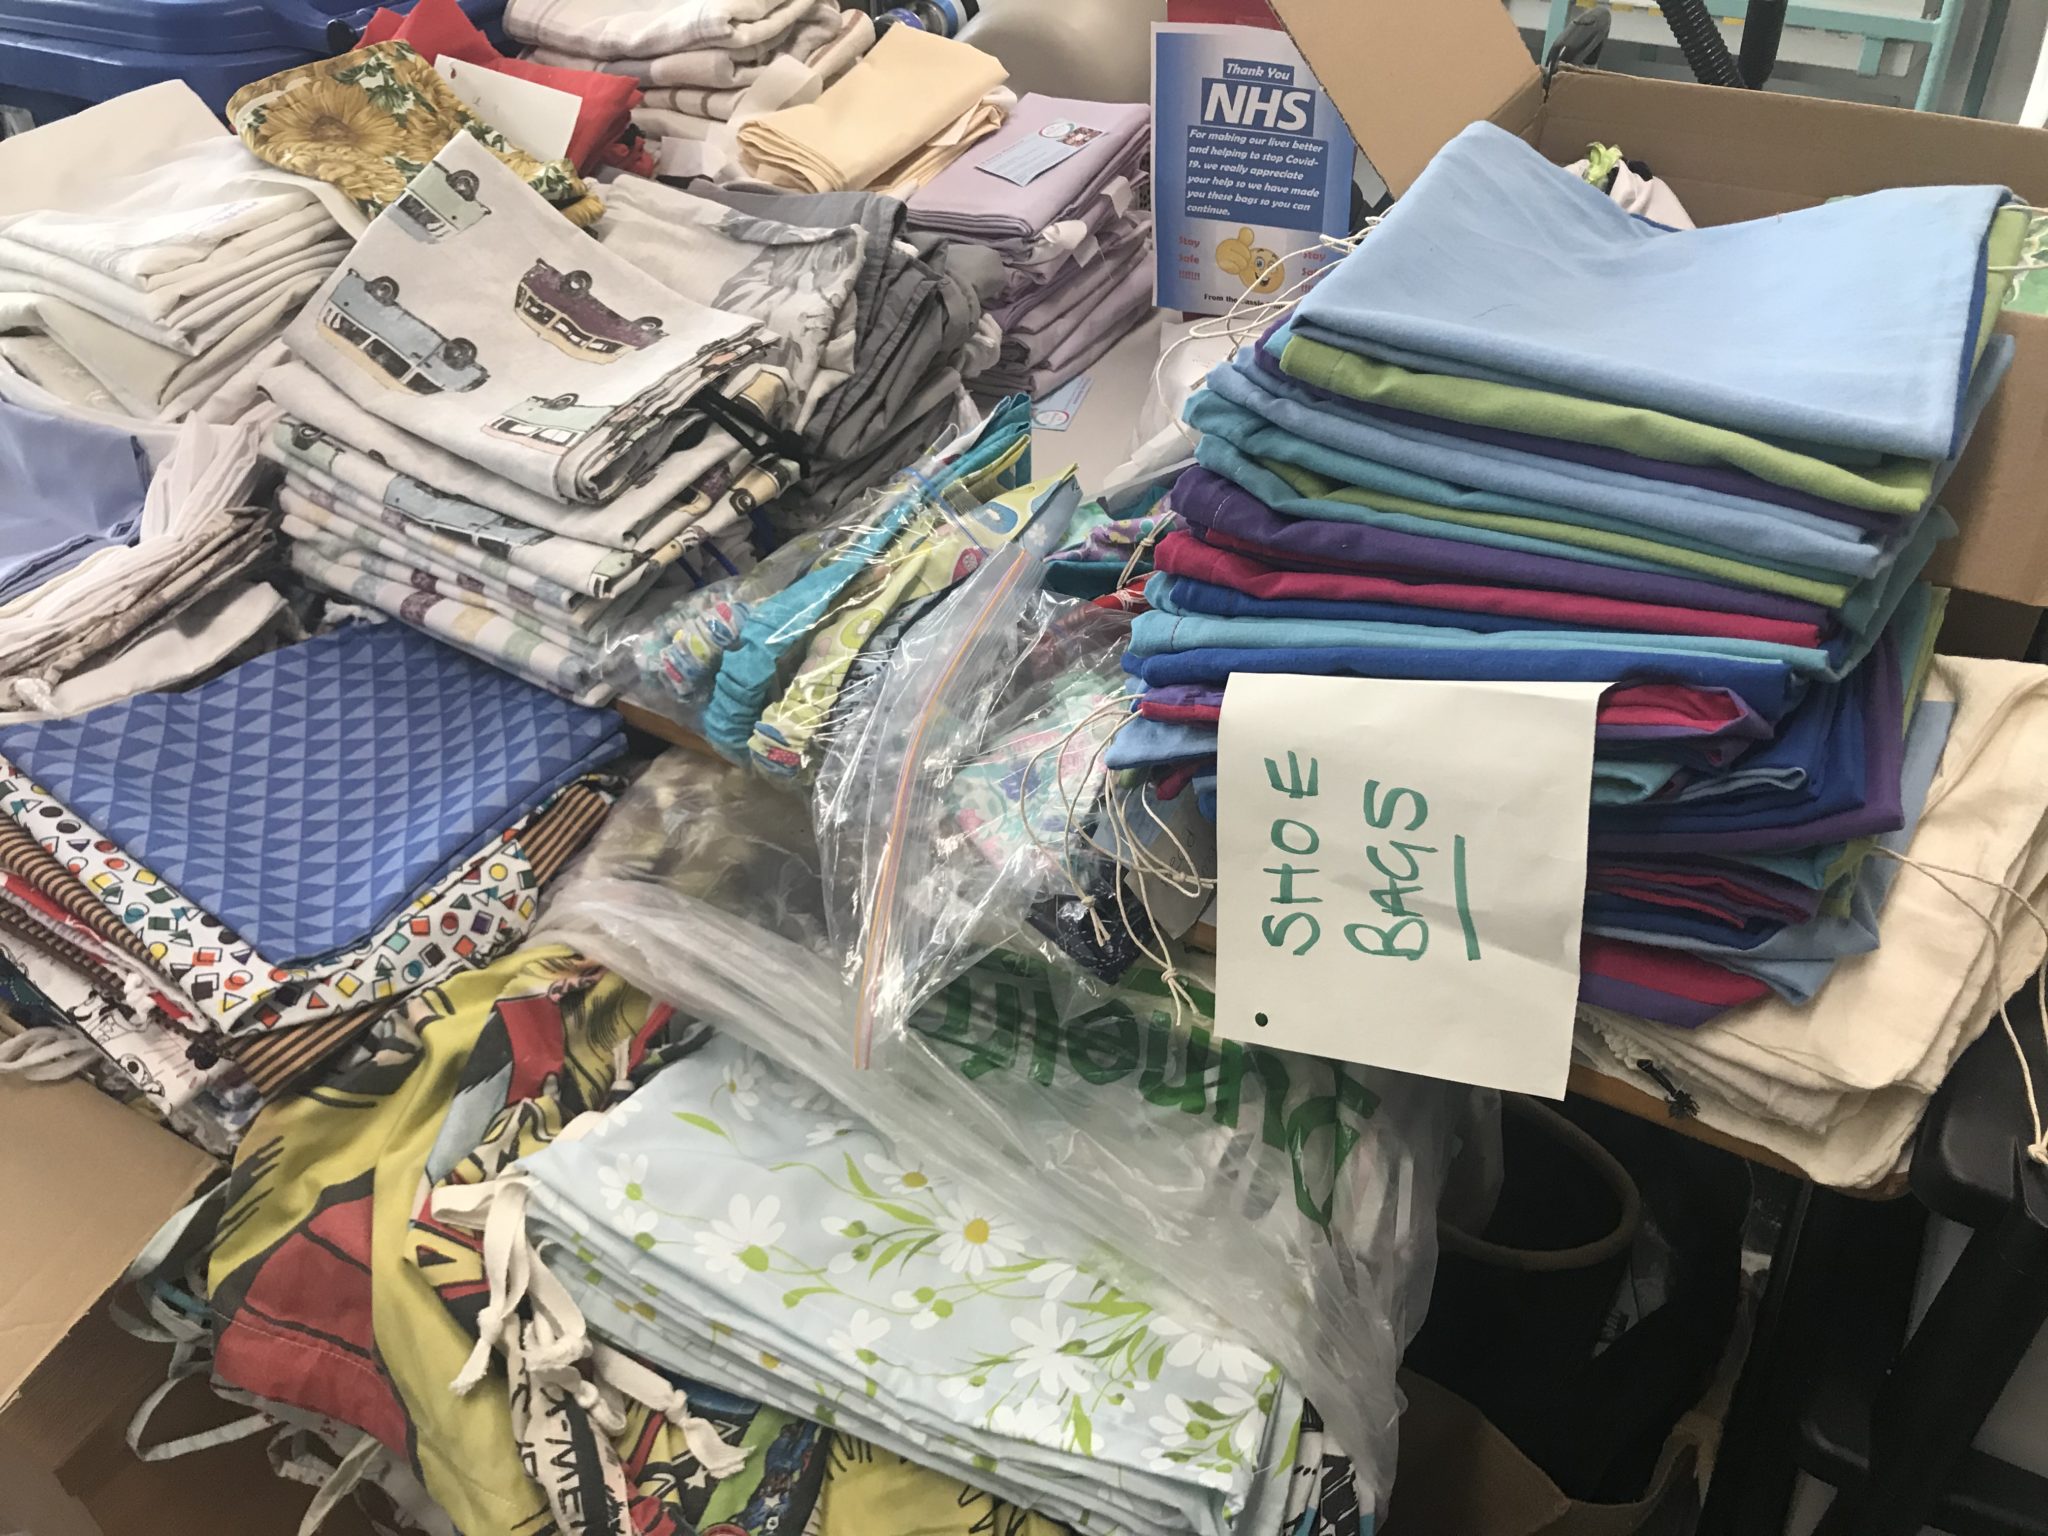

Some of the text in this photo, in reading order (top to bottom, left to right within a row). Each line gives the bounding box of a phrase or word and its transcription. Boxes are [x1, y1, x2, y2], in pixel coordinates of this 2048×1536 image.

[1226, 63, 1290, 80] Thank You
[1203, 82, 1311, 131] NHS
[1188, 129, 1323, 152] For making our lives better
[1189, 145, 1319, 166] and helping to stop Covid-
[1203, 162, 1218, 170] we
[1220, 163, 1248, 174] really
[1250, 166, 1304, 180] appreciate
[1187, 175, 1211, 185] your
[1212, 176, 1234, 188] help
[1248, 183, 1262, 191] we
[1264, 183, 1289, 194] have
[1290, 187, 1320, 198] made
[1186, 204, 1231, 216] continue.
[1187, 190, 1206, 199] you
[1207, 190, 1233, 201] these
[1234, 194, 1258, 205] bags
[1271, 200, 1291, 209] you
[1292, 203, 1311, 211] can
[1179, 235, 1200, 249] Stay
[1178, 252, 1200, 265] Safe
[1204, 293, 1224, 302] From
[1262, 750, 1323, 956] SHOE
[1343, 778, 1439, 961] BAGS
